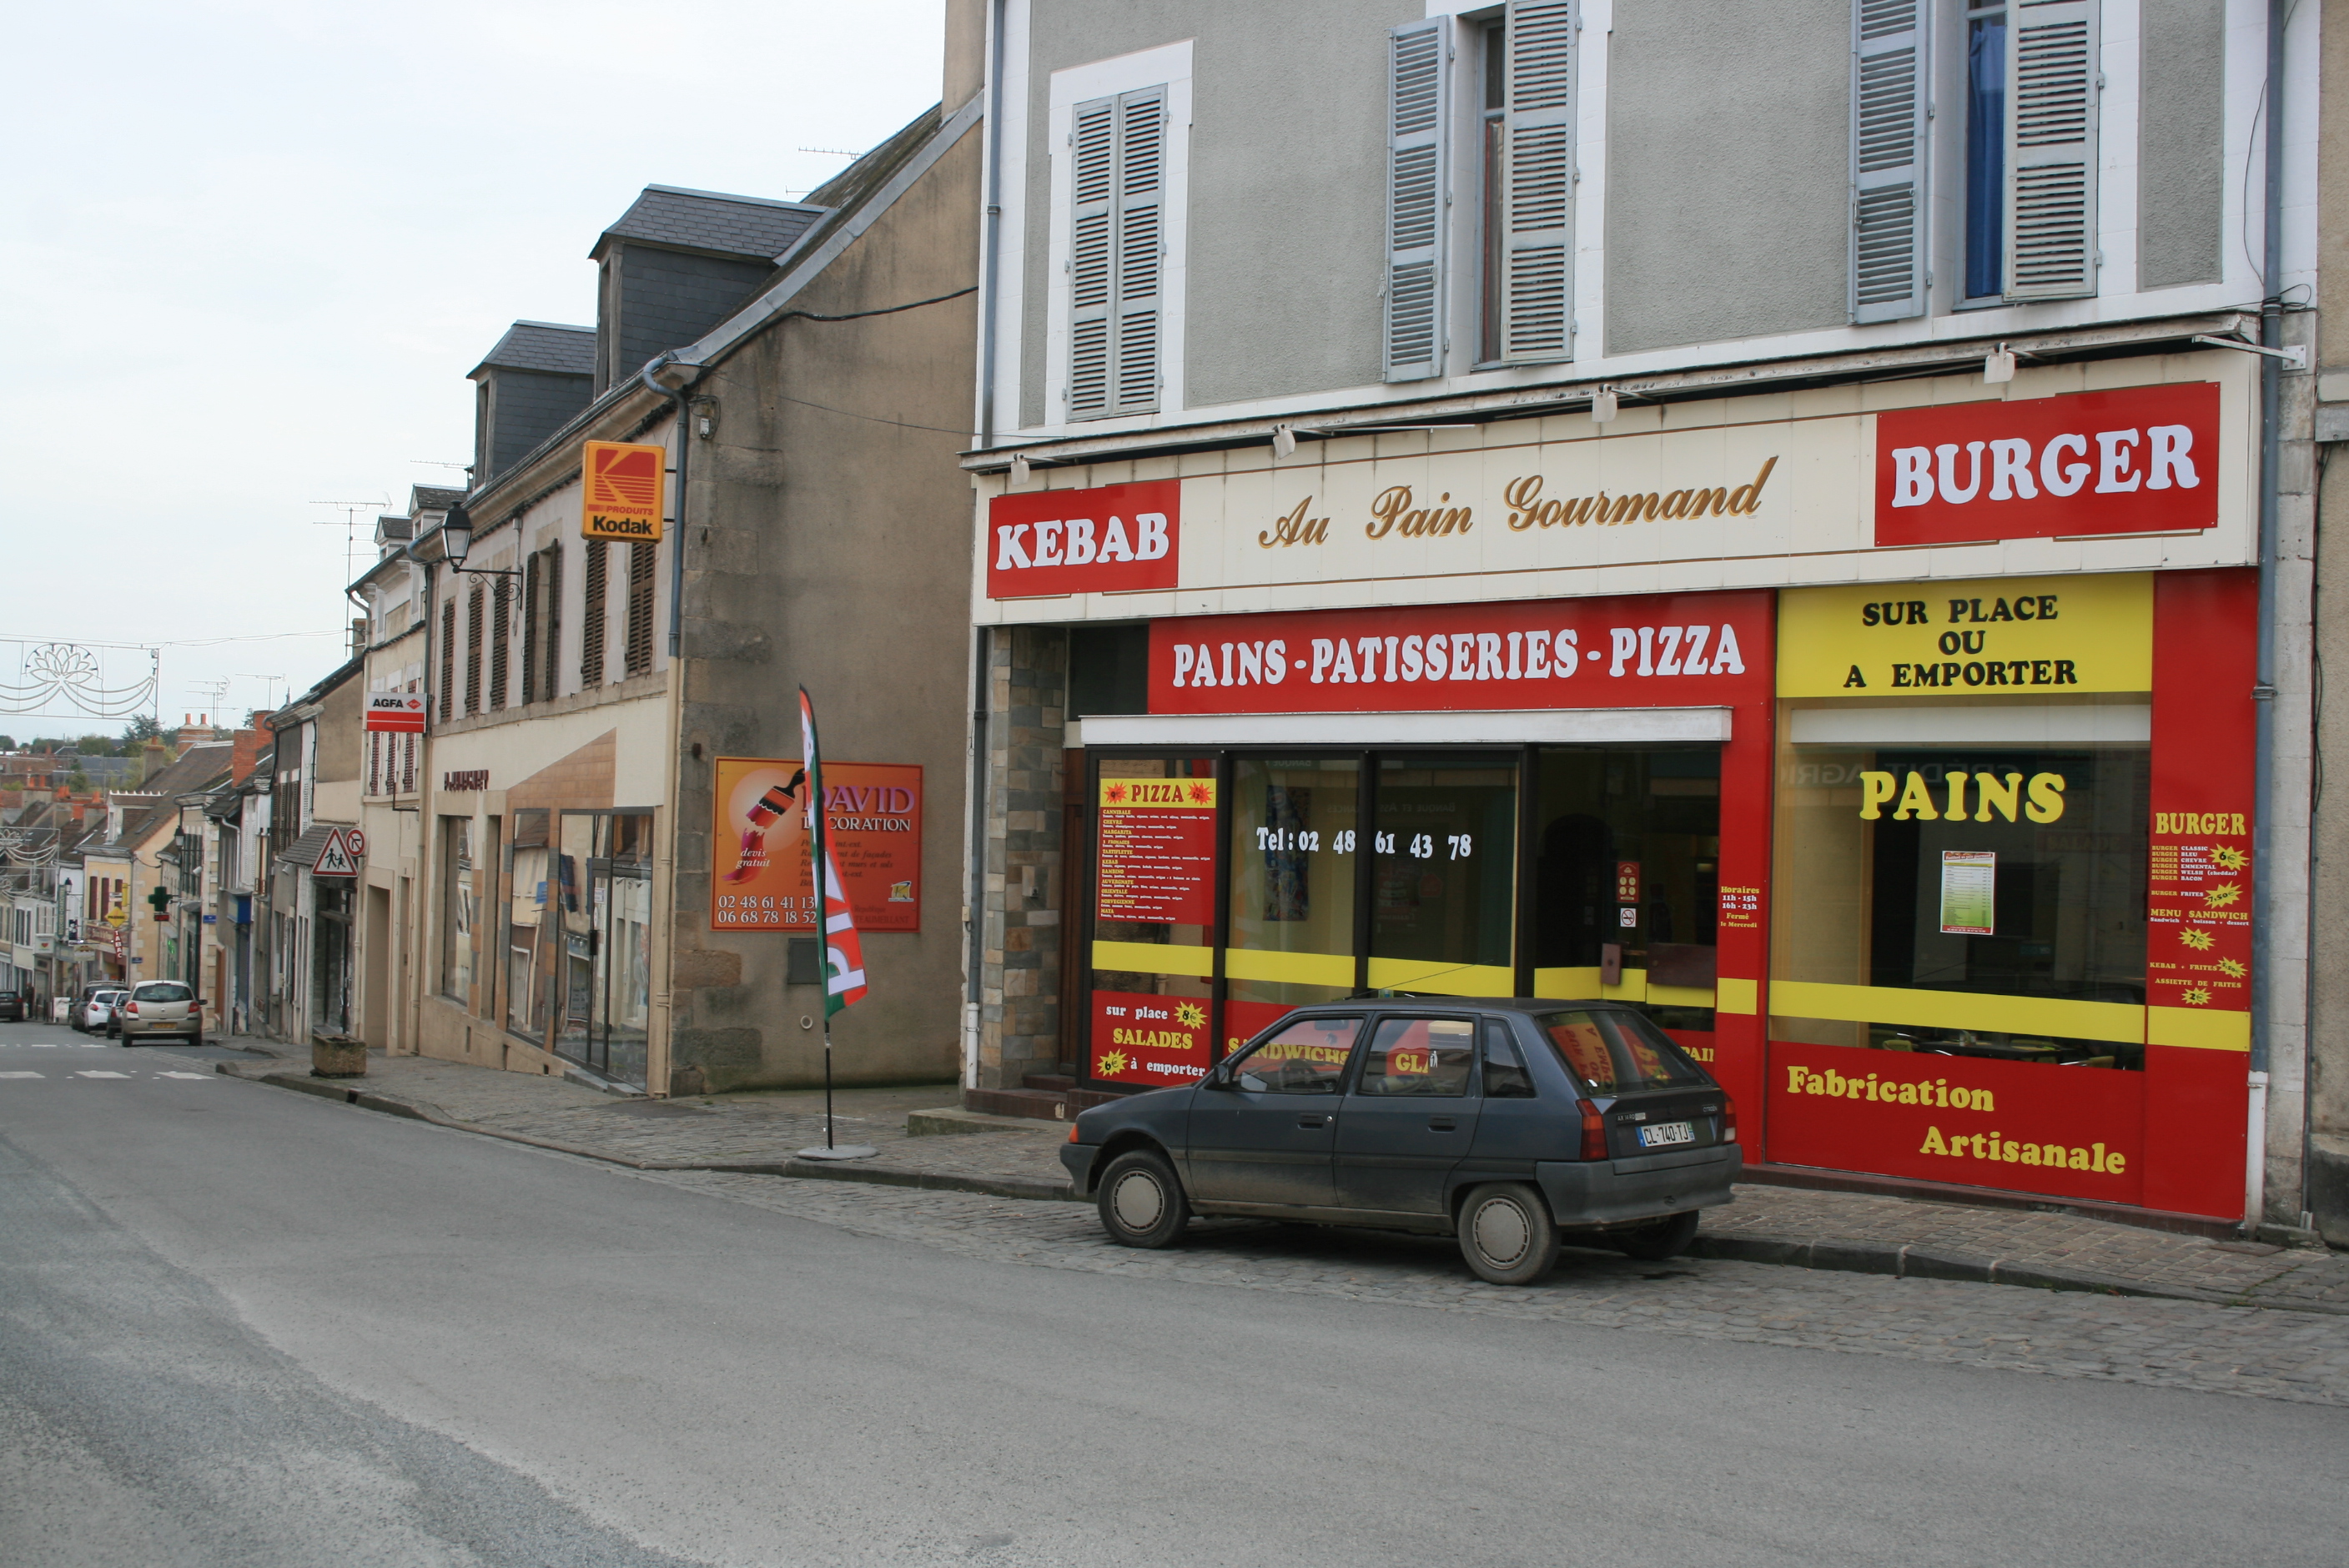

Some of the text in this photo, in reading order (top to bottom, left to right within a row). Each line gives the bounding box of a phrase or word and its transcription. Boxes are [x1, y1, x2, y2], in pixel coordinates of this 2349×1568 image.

[1891, 424, 2200, 508] BURGER
[606, 505, 654, 515] PRODUITS
[1259, 454, 1779, 548] Au Pain Gourmand
[593, 515, 653, 535] Kodak
[996, 512, 1169, 570] KEBAB
[1862, 595, 2058, 627] SUR PLACE
[1938, 630, 1986, 656] OU
[1172, 640, 1286, 688] PAINS
[1310, 629, 1579, 684] PATISSERIES
[1609, 623, 1746, 678] PIZZA
[1843, 659, 2078, 689] A EMPORTER
[373, 699, 404, 708] AGFA
[1131, 784, 1184, 802] PIZZA
[1859, 771, 2066, 824] PAINS
[803, 817, 911, 832] CORATION
[2155, 812, 2246, 836] BURGER
[740, 847, 767, 857] devis
[1298, 831, 1319, 852] 02
[1333, 830, 1356, 854] 48
[1375, 830, 1396, 854] 61
[1410, 833, 1432, 858] 43
[1447, 834, 1471, 860] 78
[736, 858, 770, 869] gratuit
[1721, 886, 1760, 894] Horaires
[718, 895, 815, 909] 02 48 61 41 13
[718, 911, 817, 923] 06 68 78 18 52
[2150, 908, 2248, 920] MENU SANDWICH
[1105, 1006, 1168, 1020] sur place
[1113, 1028, 1193, 1050] SALADES
[1228, 1038, 1350, 1066] SNDWICHS
[1130, 1057, 1205, 1077] à emporter
[1787, 1065, 1994, 1112] Fabrication
[1919, 1125, 2126, 1175] Artisanale
